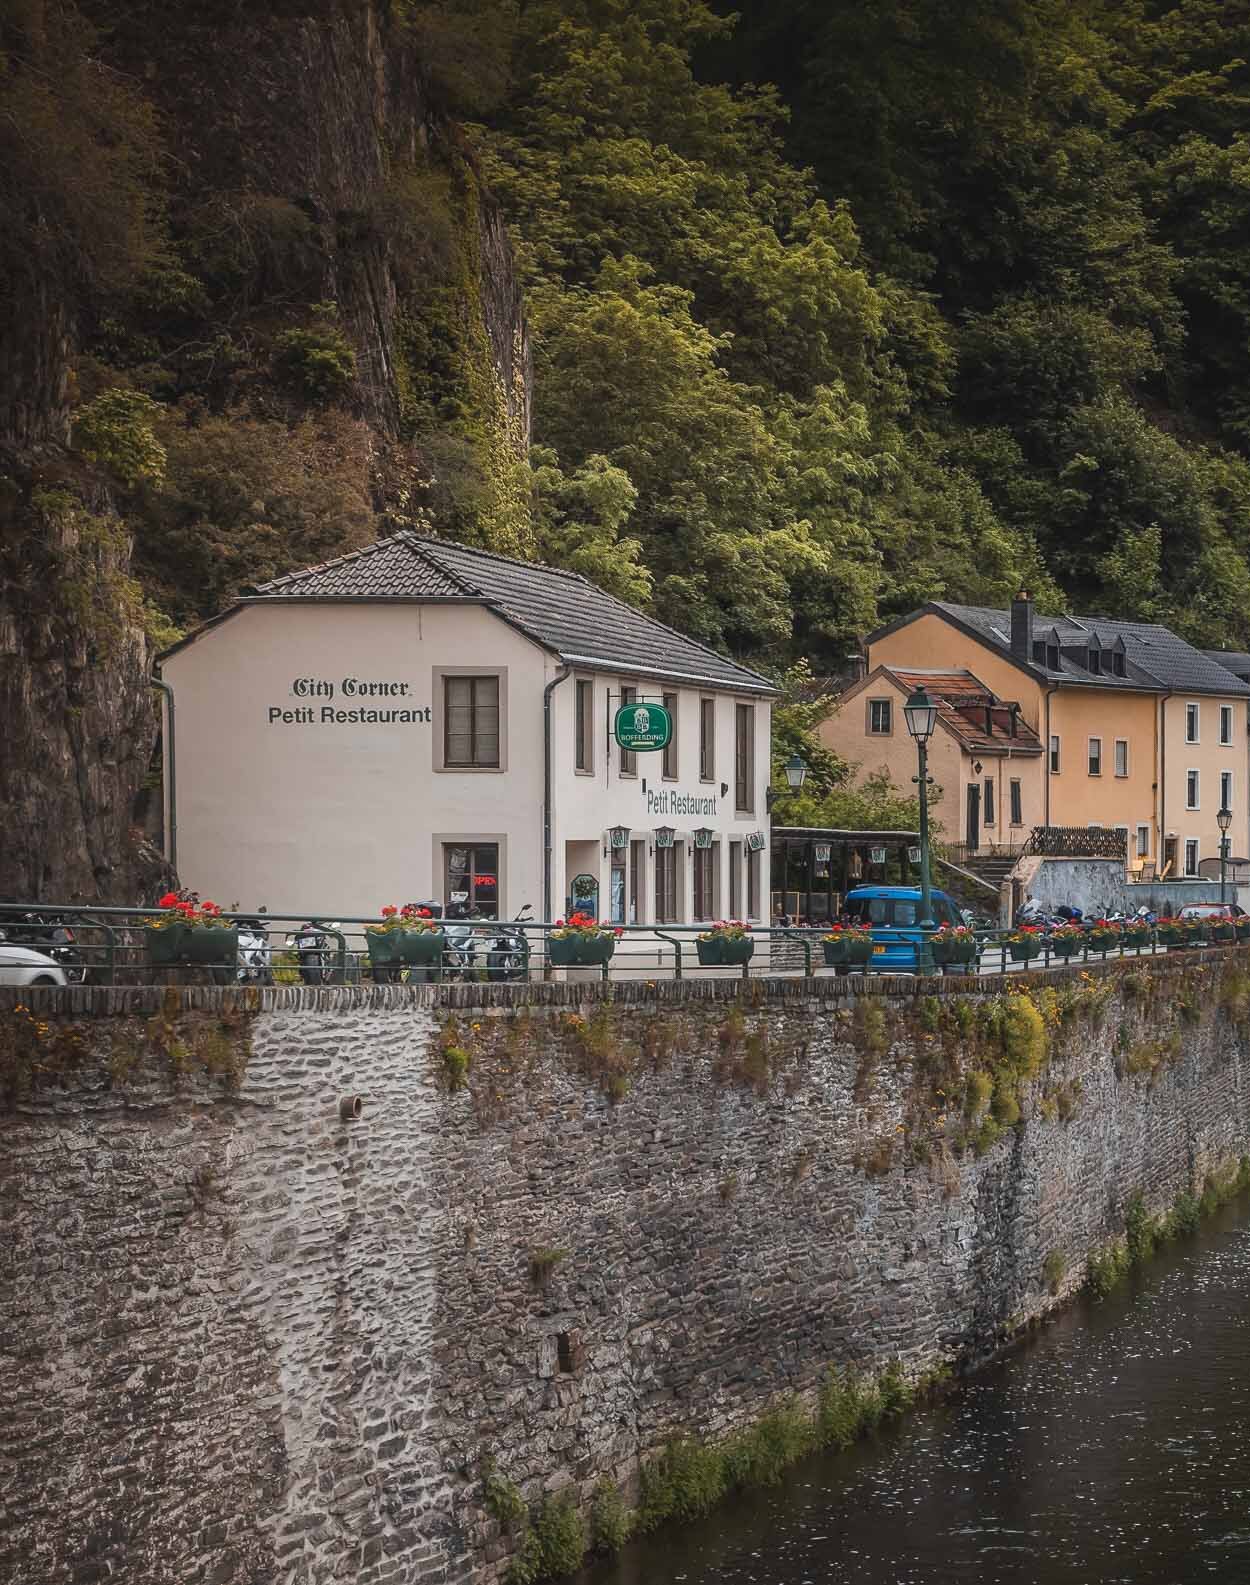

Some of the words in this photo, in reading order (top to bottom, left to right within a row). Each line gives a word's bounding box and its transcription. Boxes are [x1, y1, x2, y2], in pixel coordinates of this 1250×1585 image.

[293, 678, 334, 700] City
[342, 678, 409, 697] Corner
[268, 707, 315, 723] Petit
[321, 707, 432, 723] Restaurant
[647, 789, 669, 814] Petit
[670, 790, 717, 816] Restaurant
